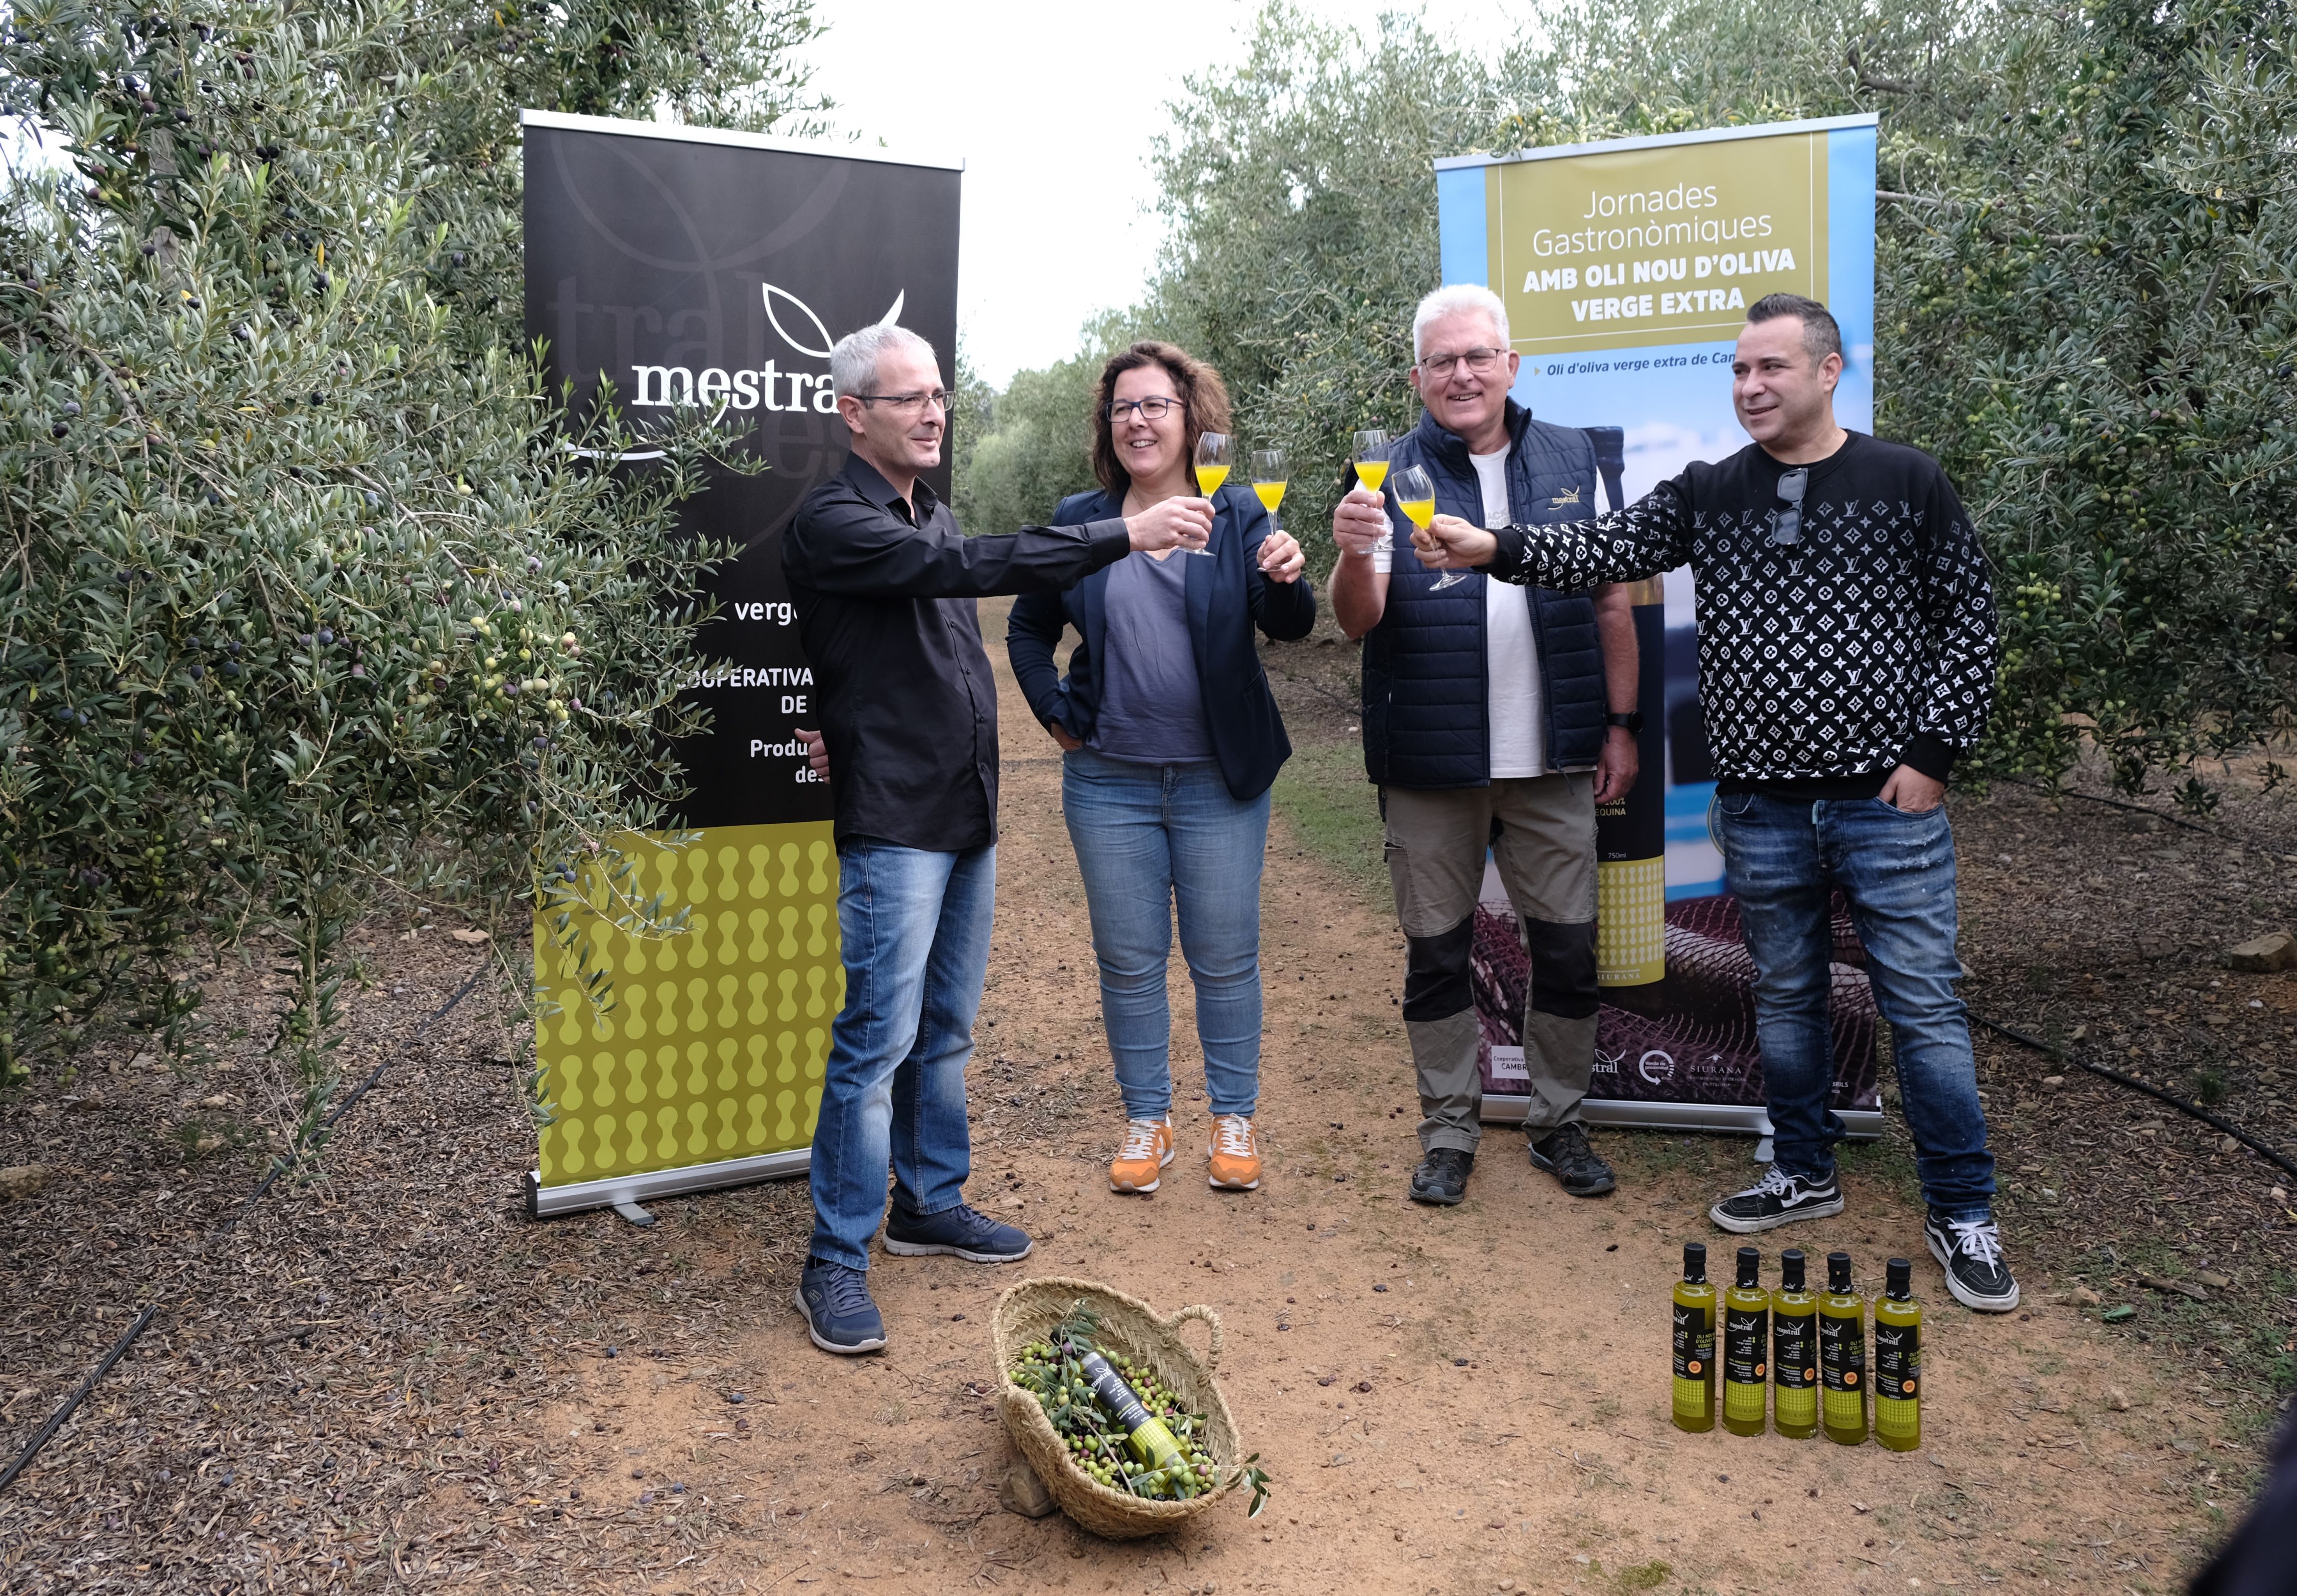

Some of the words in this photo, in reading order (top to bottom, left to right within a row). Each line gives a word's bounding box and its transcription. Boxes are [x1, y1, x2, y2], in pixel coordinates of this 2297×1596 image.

[1583, 182, 1717, 218] Jornades
[1533, 215, 1772, 257] Gastronòmiques
[1523, 267, 1578, 293] AMB
[1585, 263, 1625, 287] OLI
[1633, 258, 1687, 284] NOU
[1695, 248, 1796, 278] D'OLIVA
[1571, 294, 1653, 322] VERGE
[1661, 287, 1745, 315] EXTRA
[1547, 364, 1563, 376] Oli
[1568, 361, 1609, 374] d'oliva
[1614, 359, 1649, 373] verge
[1654, 355, 1687, 368] extra
[1691, 353, 1708, 365] de
[631, 359, 840, 414] mestra
[1552, 495, 1579, 504] mestral
[735, 602, 797, 626] verg
[781, 695, 807, 714] DE
[751, 739, 809, 757] Produ
[1595, 808, 1626, 816] EQUINA
[1592, 1062, 1619, 1073] stral
[1690, 1065, 1742, 1074] SIURANA
[1729, 1321, 1752, 1331] mestral
[1777, 1326, 1800, 1336] mestral
[1091, 1368, 1113, 1388] mestral
[1880, 1421, 1911, 1430] SIURANA
